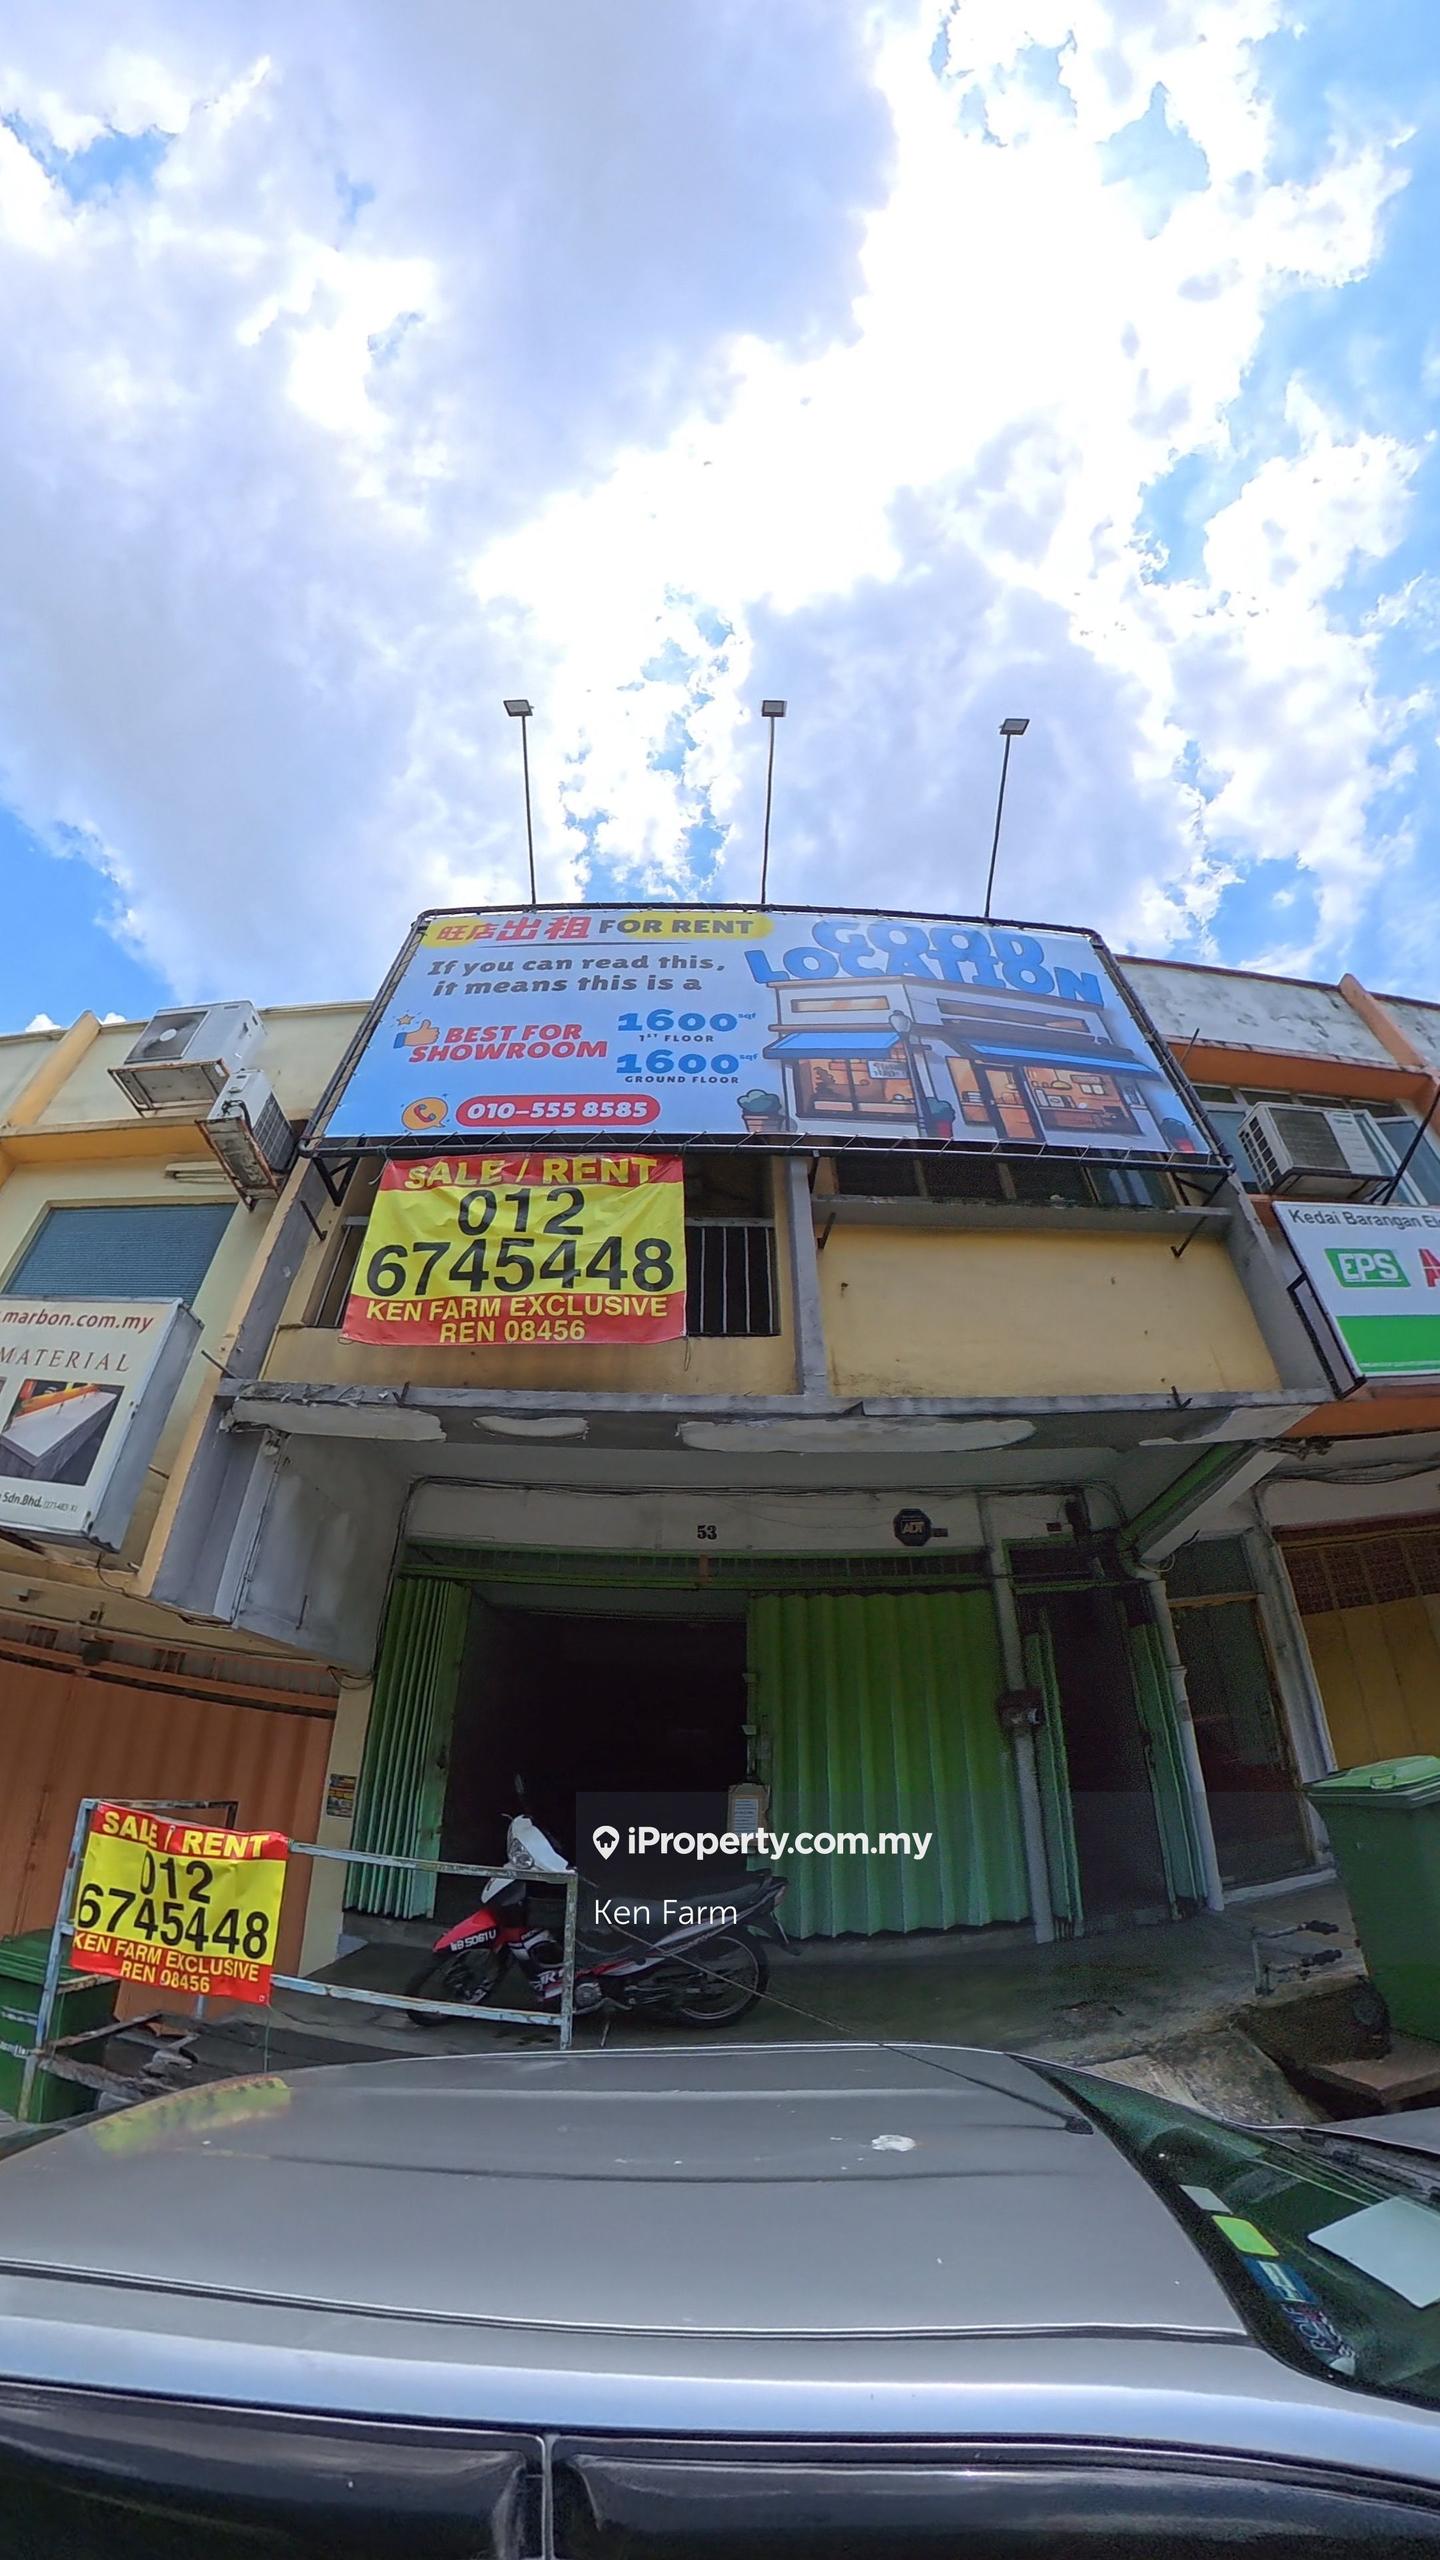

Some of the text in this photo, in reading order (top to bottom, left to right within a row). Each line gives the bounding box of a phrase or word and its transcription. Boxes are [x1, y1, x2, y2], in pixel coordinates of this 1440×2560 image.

[436, 915, 593, 942] 旺店出租
[599, 919, 754, 934] FOR RENT
[811, 920, 1046, 966] GOOD
[427, 955, 726, 977] If you can read this,
[744, 945, 1105, 1009] LOCATION
[432, 974, 703, 997] it means this is a
[617, 1008, 738, 1032] 1600
[444, 1024, 583, 1044] BEST FOR
[409, 1041, 608, 1062] SHOWROOM
[616, 1049, 740, 1075] 1600
[624, 1075, 740, 1084] GROUND FLOOR
[581, 1101, 648, 1119] 8585
[404, 1159, 505, 1190] SALE
[542, 1157, 658, 1185] RENT
[457, 1187, 584, 1237] 012
[1288, 1209, 1340, 1225] Kedai
[1343, 1211, 1422, 1230] Barangan
[367, 1236, 674, 1297] 6745448
[1337, 1252, 1399, 1281] EPS
[366, 1295, 668, 1322] KEN FARM EXCLUSIVE
[439, 1319, 586, 1344] REN 08456
[697, 1524, 718, 1540] 53
[902, 1521, 924, 1534] ADT
[102, 1811, 158, 1847] SALE
[181, 1830, 270, 1858] RENT
[140, 1851, 214, 1905] 012
[77, 1883, 269, 1960] 6745448
[72, 1931, 259, 1982] KEN FARM EXCLUSIVE
[120, 1960, 210, 1993] REN 08456
